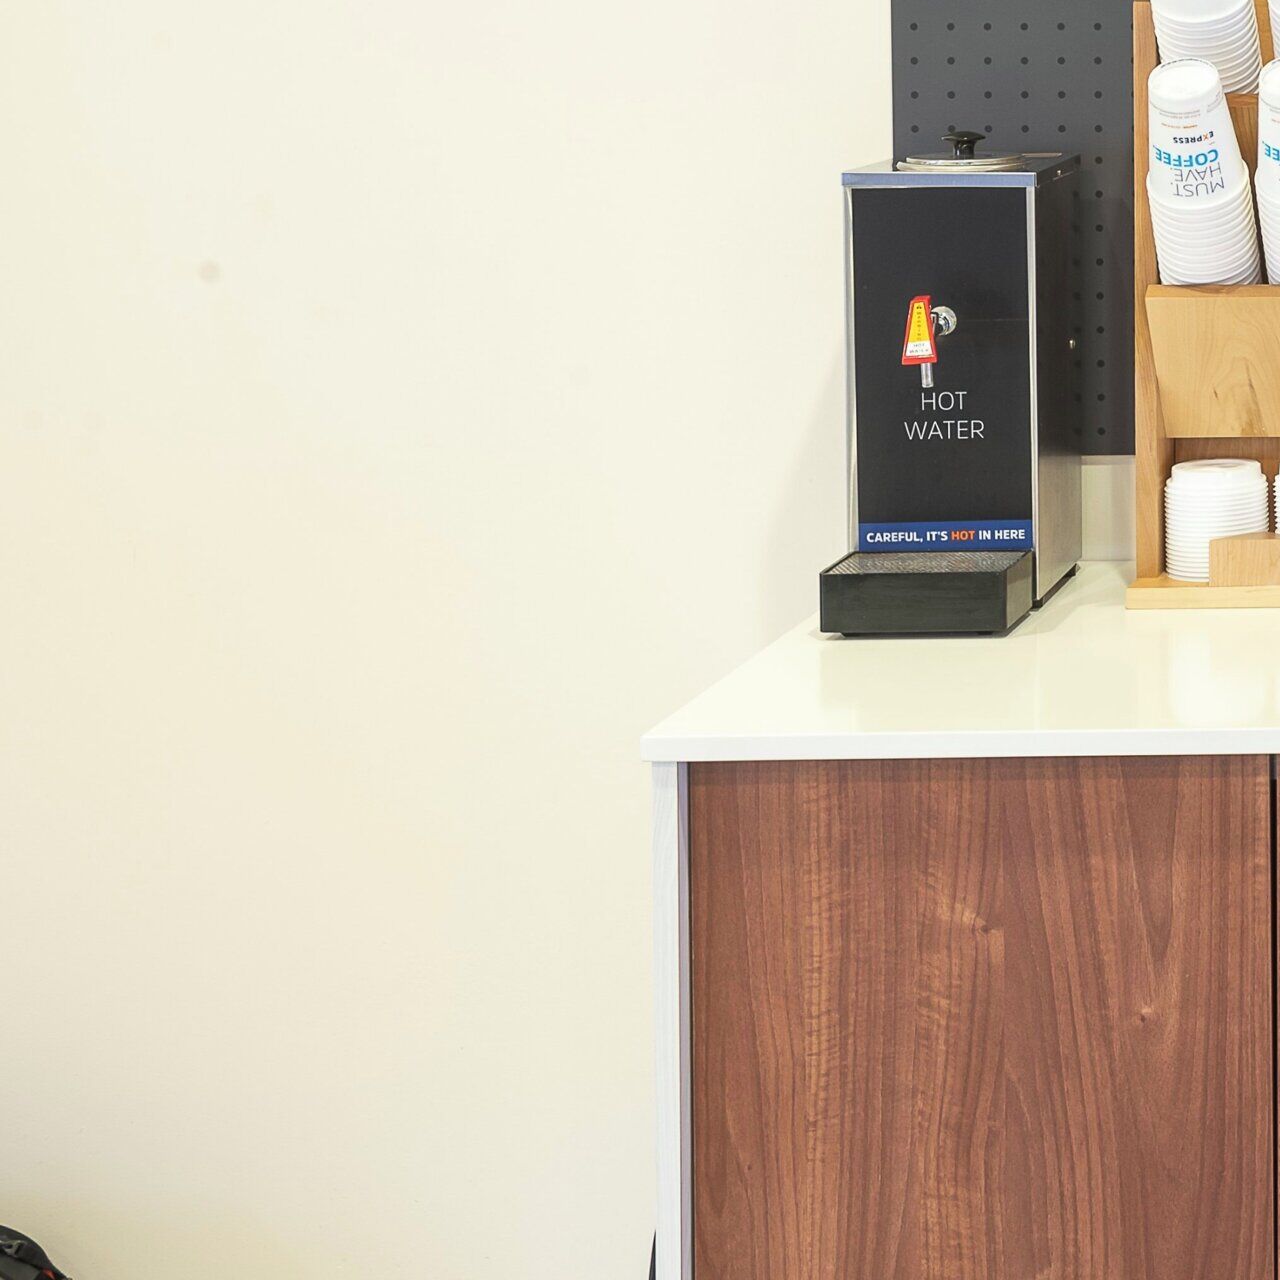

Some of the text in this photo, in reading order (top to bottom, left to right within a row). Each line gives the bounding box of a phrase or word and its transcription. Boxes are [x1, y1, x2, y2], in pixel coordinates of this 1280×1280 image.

[1173, 130, 1214, 144] EXPRESS
[1153, 144, 1219, 168] COFFEE.
[1170, 161, 1222, 183] HAVE.
[1170, 175, 1225, 198] MUST.
[921, 391, 967, 411] HOT
[904, 419, 985, 440] WATER
[866, 529, 1025, 543] CAREFUL, IT'S HOT IN HERE
